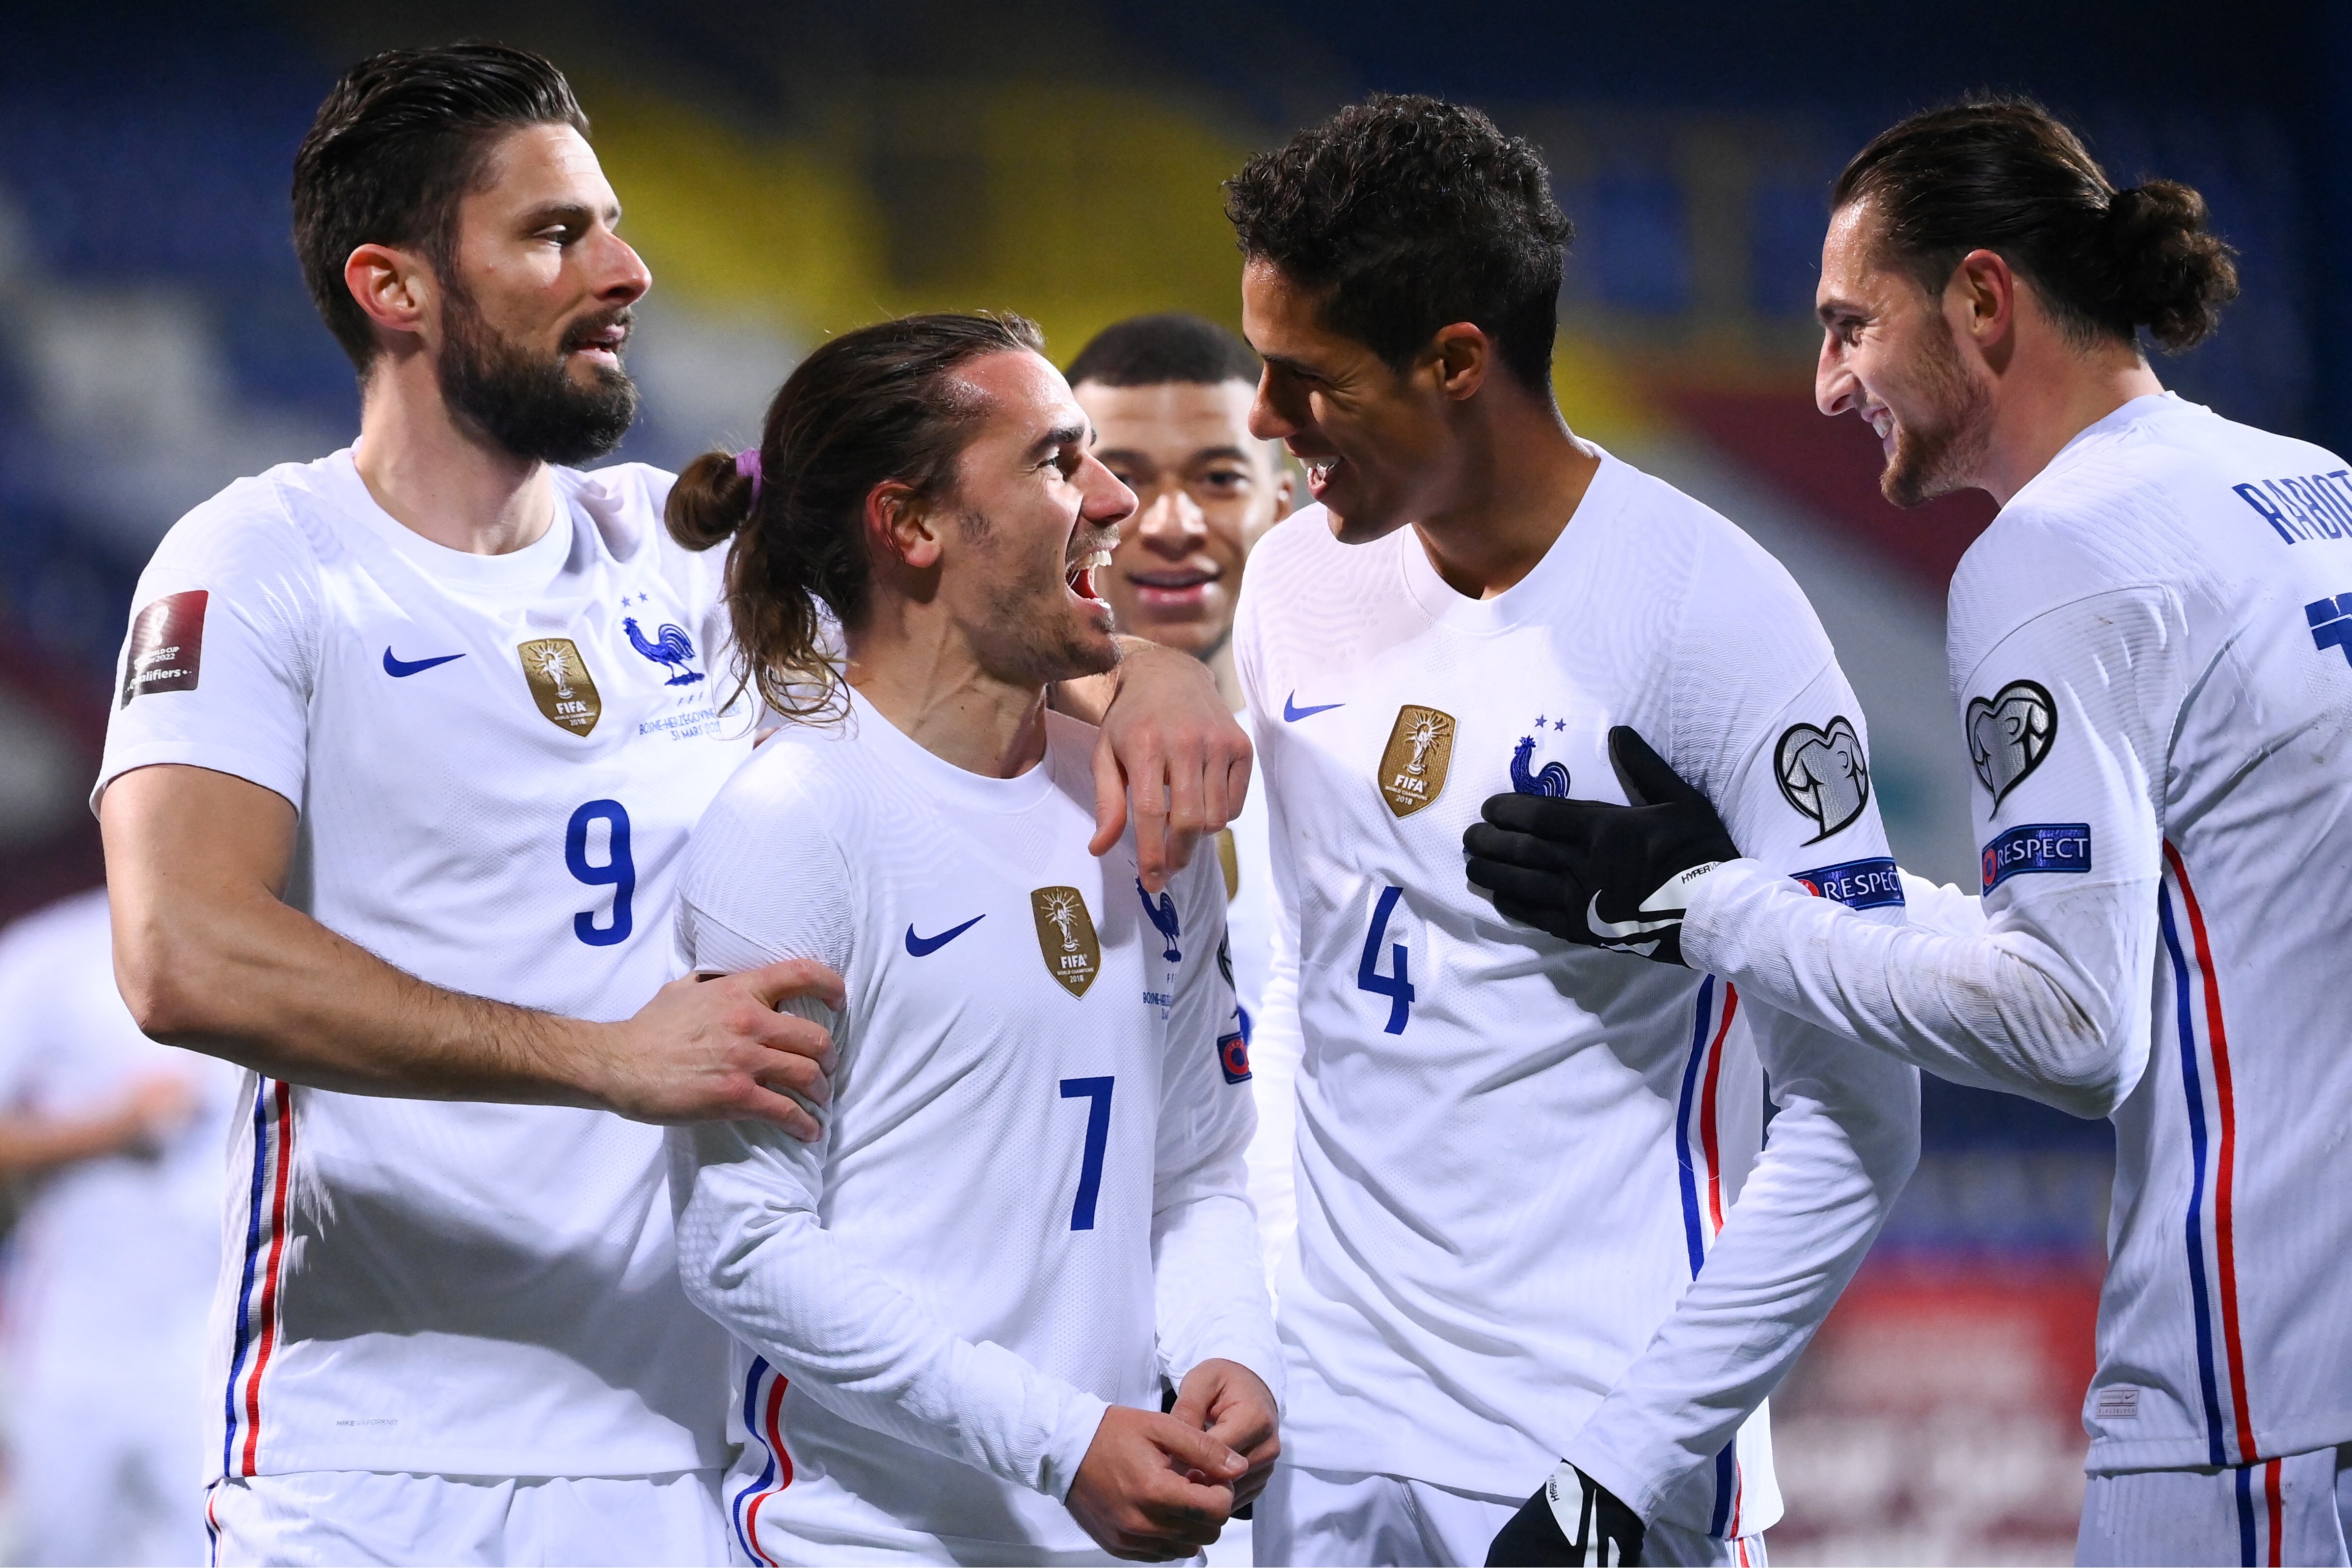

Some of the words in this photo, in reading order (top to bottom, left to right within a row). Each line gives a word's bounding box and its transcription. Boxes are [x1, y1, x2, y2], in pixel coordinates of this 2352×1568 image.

[145, 648, 165, 658] ORLD
[130, 669, 181, 690] Qalifiers
[556, 701, 587, 715] FIFA
[1385, 785, 1401, 794] WORLD
[1402, 790, 1428, 800] CHAMPIONS
[1395, 774, 1423, 793] FIFA
[1396, 795, 1413, 805] 2018
[1997, 838, 2088, 870] RESPECT
[565, 799, 635, 946] 9
[1823, 872, 1902, 900] RESPECT
[1060, 955, 1087, 969] FIFA
[1358, 886, 1415, 1035] 4
[1069, 975, 1084, 983] 2018
[1059, 1076, 1114, 1231] 7
